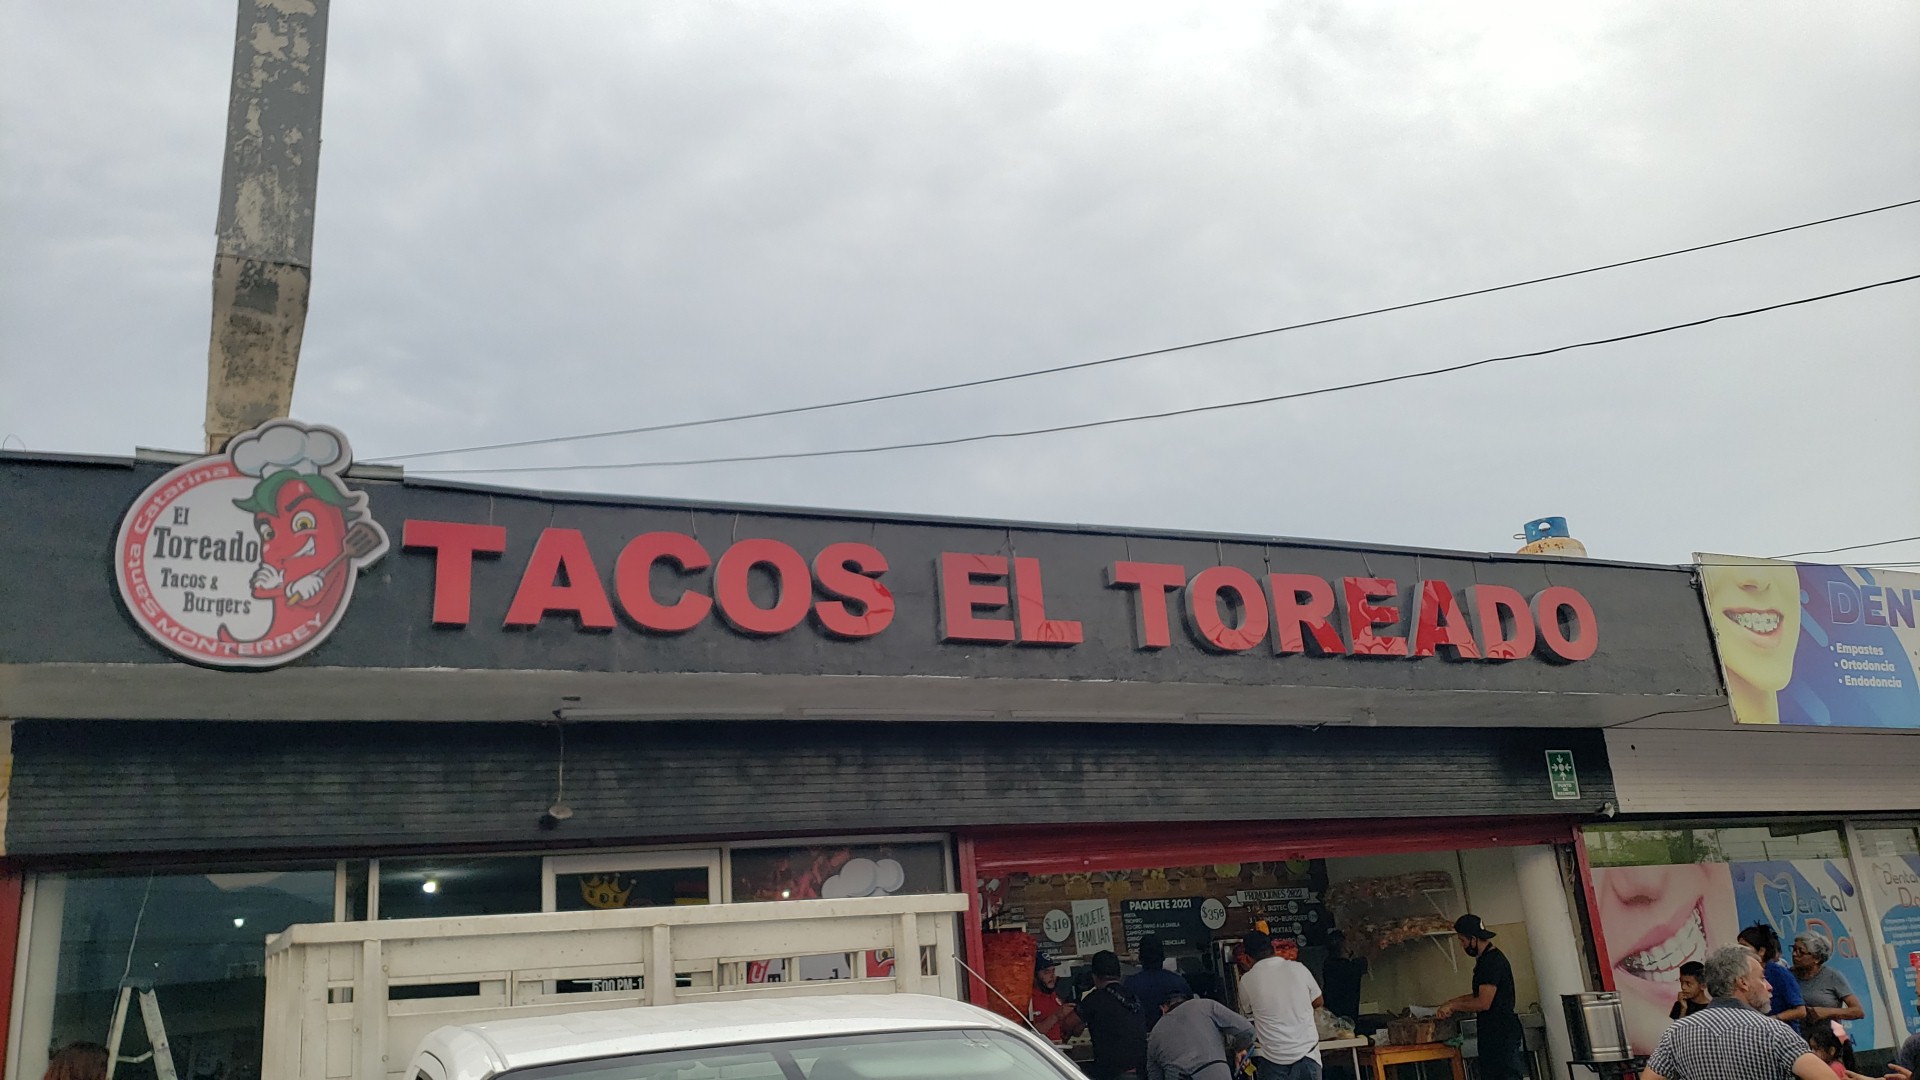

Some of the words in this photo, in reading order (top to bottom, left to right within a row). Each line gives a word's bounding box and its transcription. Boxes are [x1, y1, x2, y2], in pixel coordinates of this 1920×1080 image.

[135, 466, 230, 535] Catarina
[173, 506, 189, 525] El
[153, 527, 259, 563] Toreado
[128, 545, 160, 617] Santa
[161, 568, 207, 590] Tacos
[209, 578, 219, 590] &
[402, 519, 896, 637] TACOS
[937, 552, 1084, 646] EL
[1107, 560, 1600, 662] TOREADO
[183, 591, 252, 616] Burgers
[156, 612, 323, 657] MONTERREY
[1836, 643, 1884, 656] Empastes
[1840, 659, 1895, 672] Ortodoncia
[1844, 675, 1903, 688] Endodoncia
[1129, 900, 1170, 911] PAQUETE
[1171, 899, 1192, 909] 2021
[1777, 884, 1847, 914] Dental
[1045, 917, 1069, 933] $410
[1075, 906, 1105, 929] PAQUETE
[1202, 906, 1225, 921] $350
[1078, 926, 1110, 949] FAMILIAR
